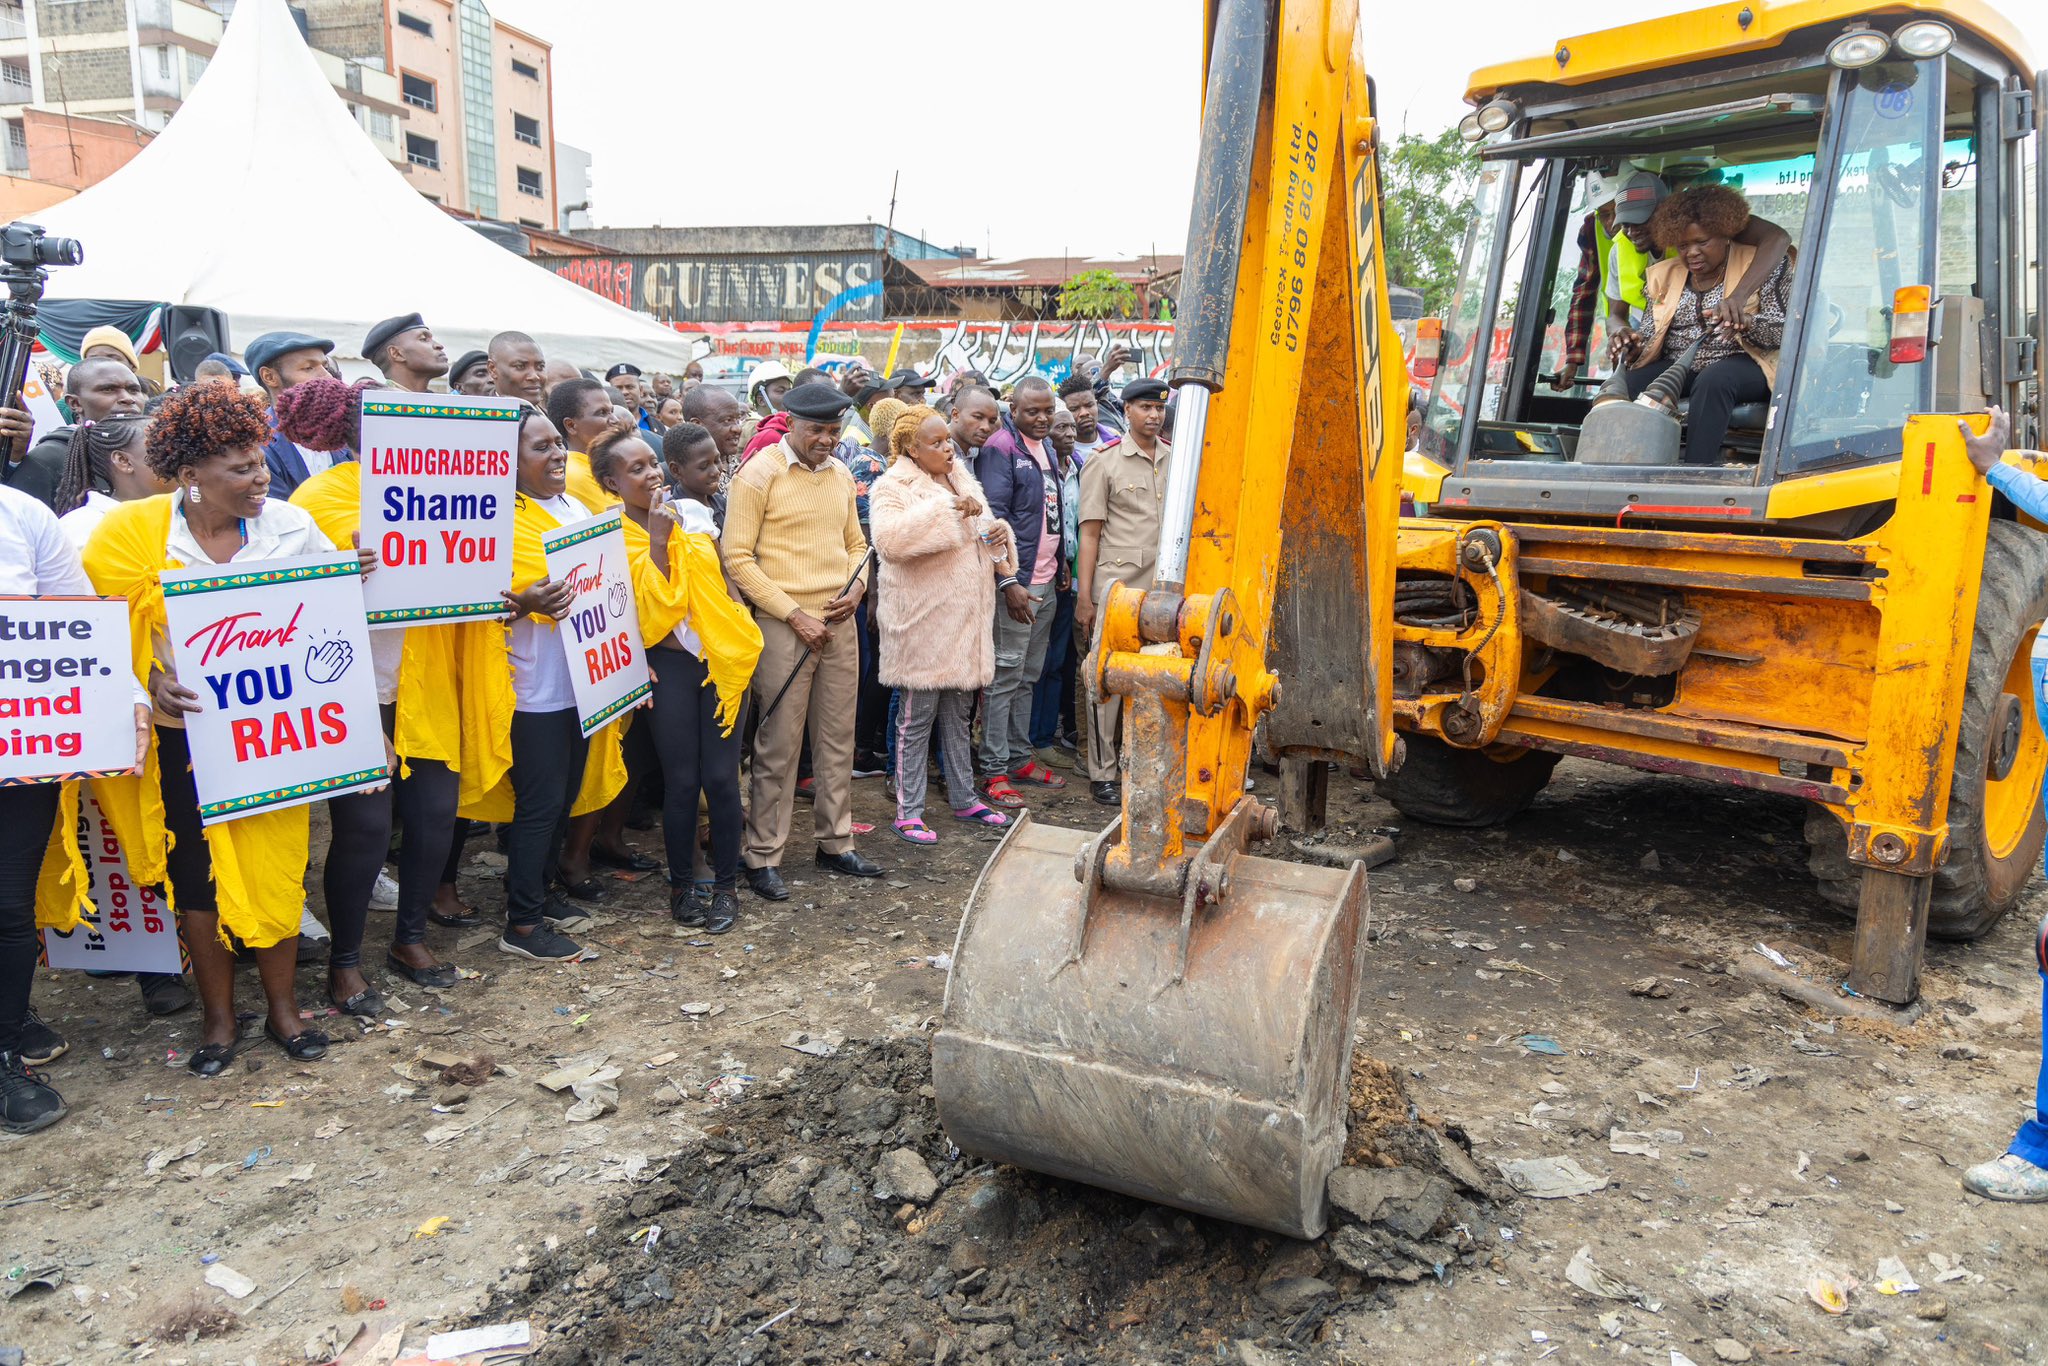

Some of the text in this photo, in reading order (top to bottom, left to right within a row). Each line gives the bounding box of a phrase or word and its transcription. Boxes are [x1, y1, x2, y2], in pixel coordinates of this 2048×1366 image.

[1270, 121, 1303, 346] Georex Trading Ltd.
[1285, 275, 1303, 352] 0796
[1294, 227, 1308, 268] 80
[1305, 129, 1319, 173] 80
[643, 262, 875, 311] GUINNESS
[1353, 155, 1384, 478] JCB
[371, 447, 510, 477] LANDGRABERS
[383, 486, 497, 522] Shame
[382, 530, 496, 567] On You
[564, 553, 604, 596] Thank
[184, 602, 304, 666] Thank
[570, 603, 607, 643] YOU
[584, 631, 632, 685] RAIS
[204, 664, 293, 710] YOU
[230, 701, 348, 762] RAIS
[108, 872, 133, 933] Stop
